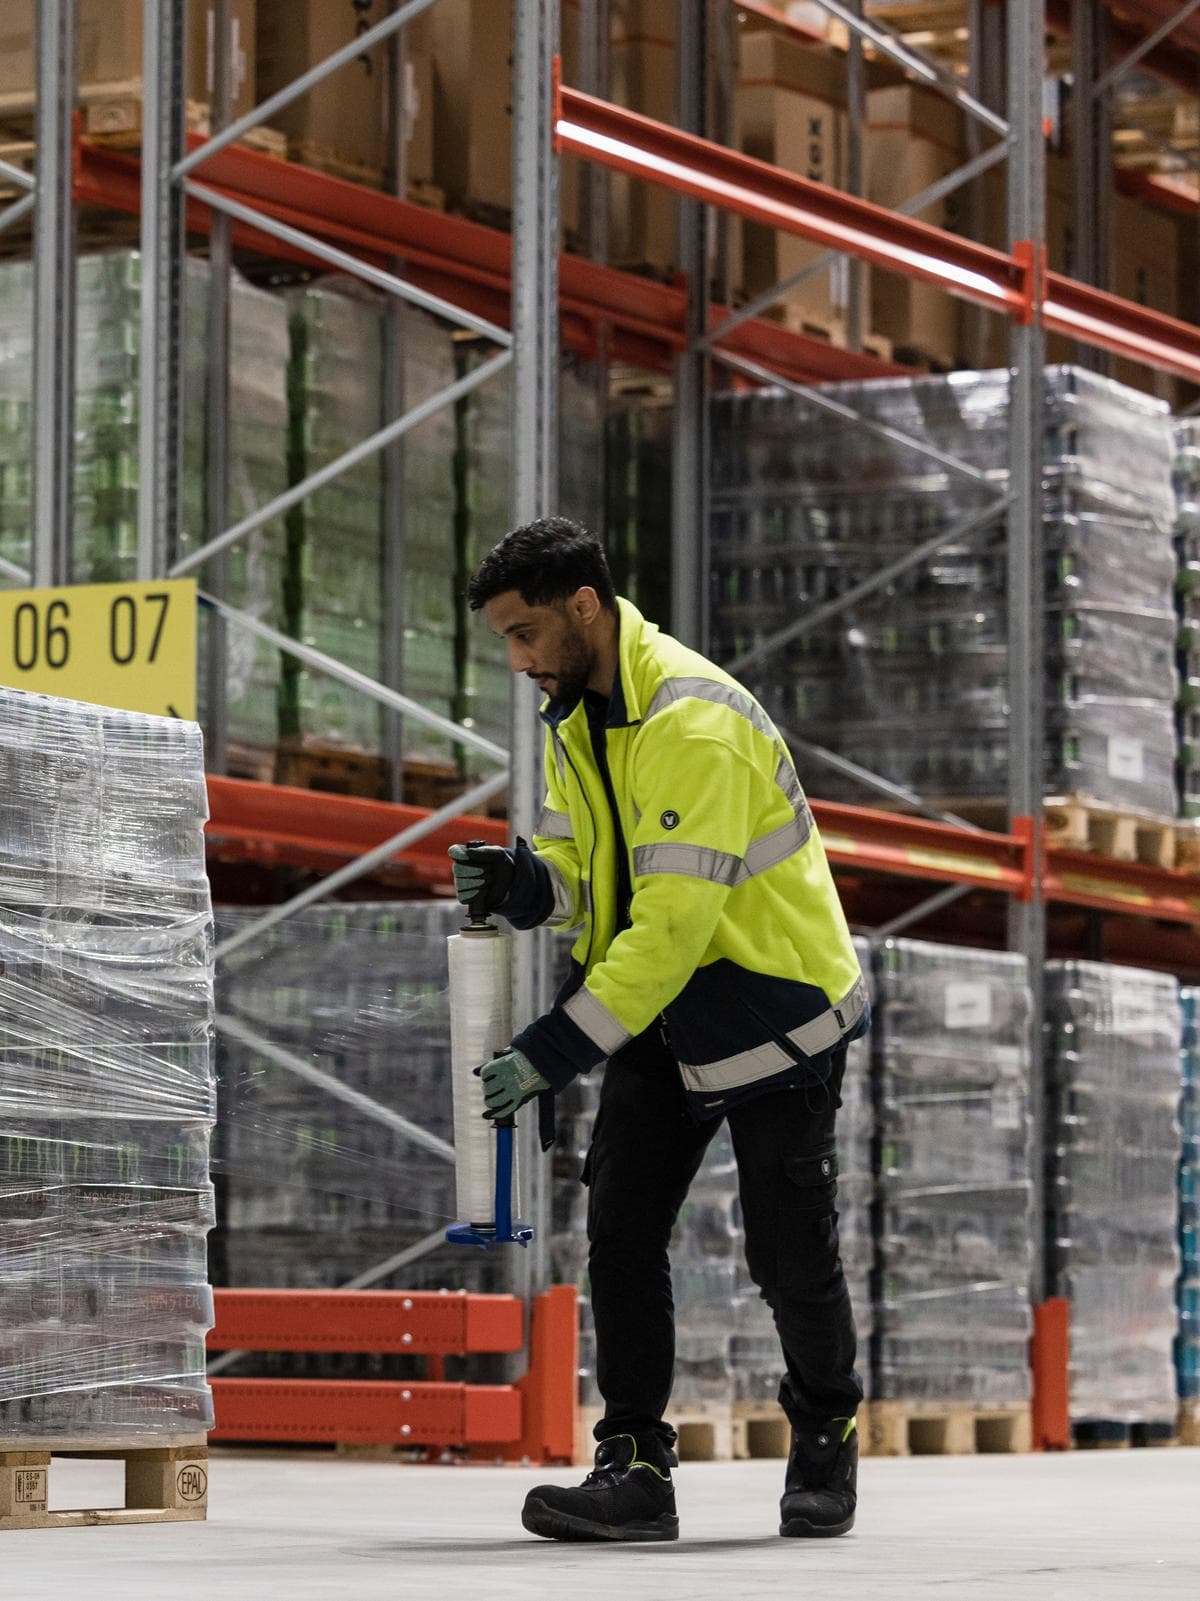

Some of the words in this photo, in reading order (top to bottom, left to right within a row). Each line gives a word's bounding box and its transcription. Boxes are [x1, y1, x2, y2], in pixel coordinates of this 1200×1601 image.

[13, 600, 70, 671] 06
[110, 593, 171, 666] 07
[182, 1471, 202, 1495] EPAL
